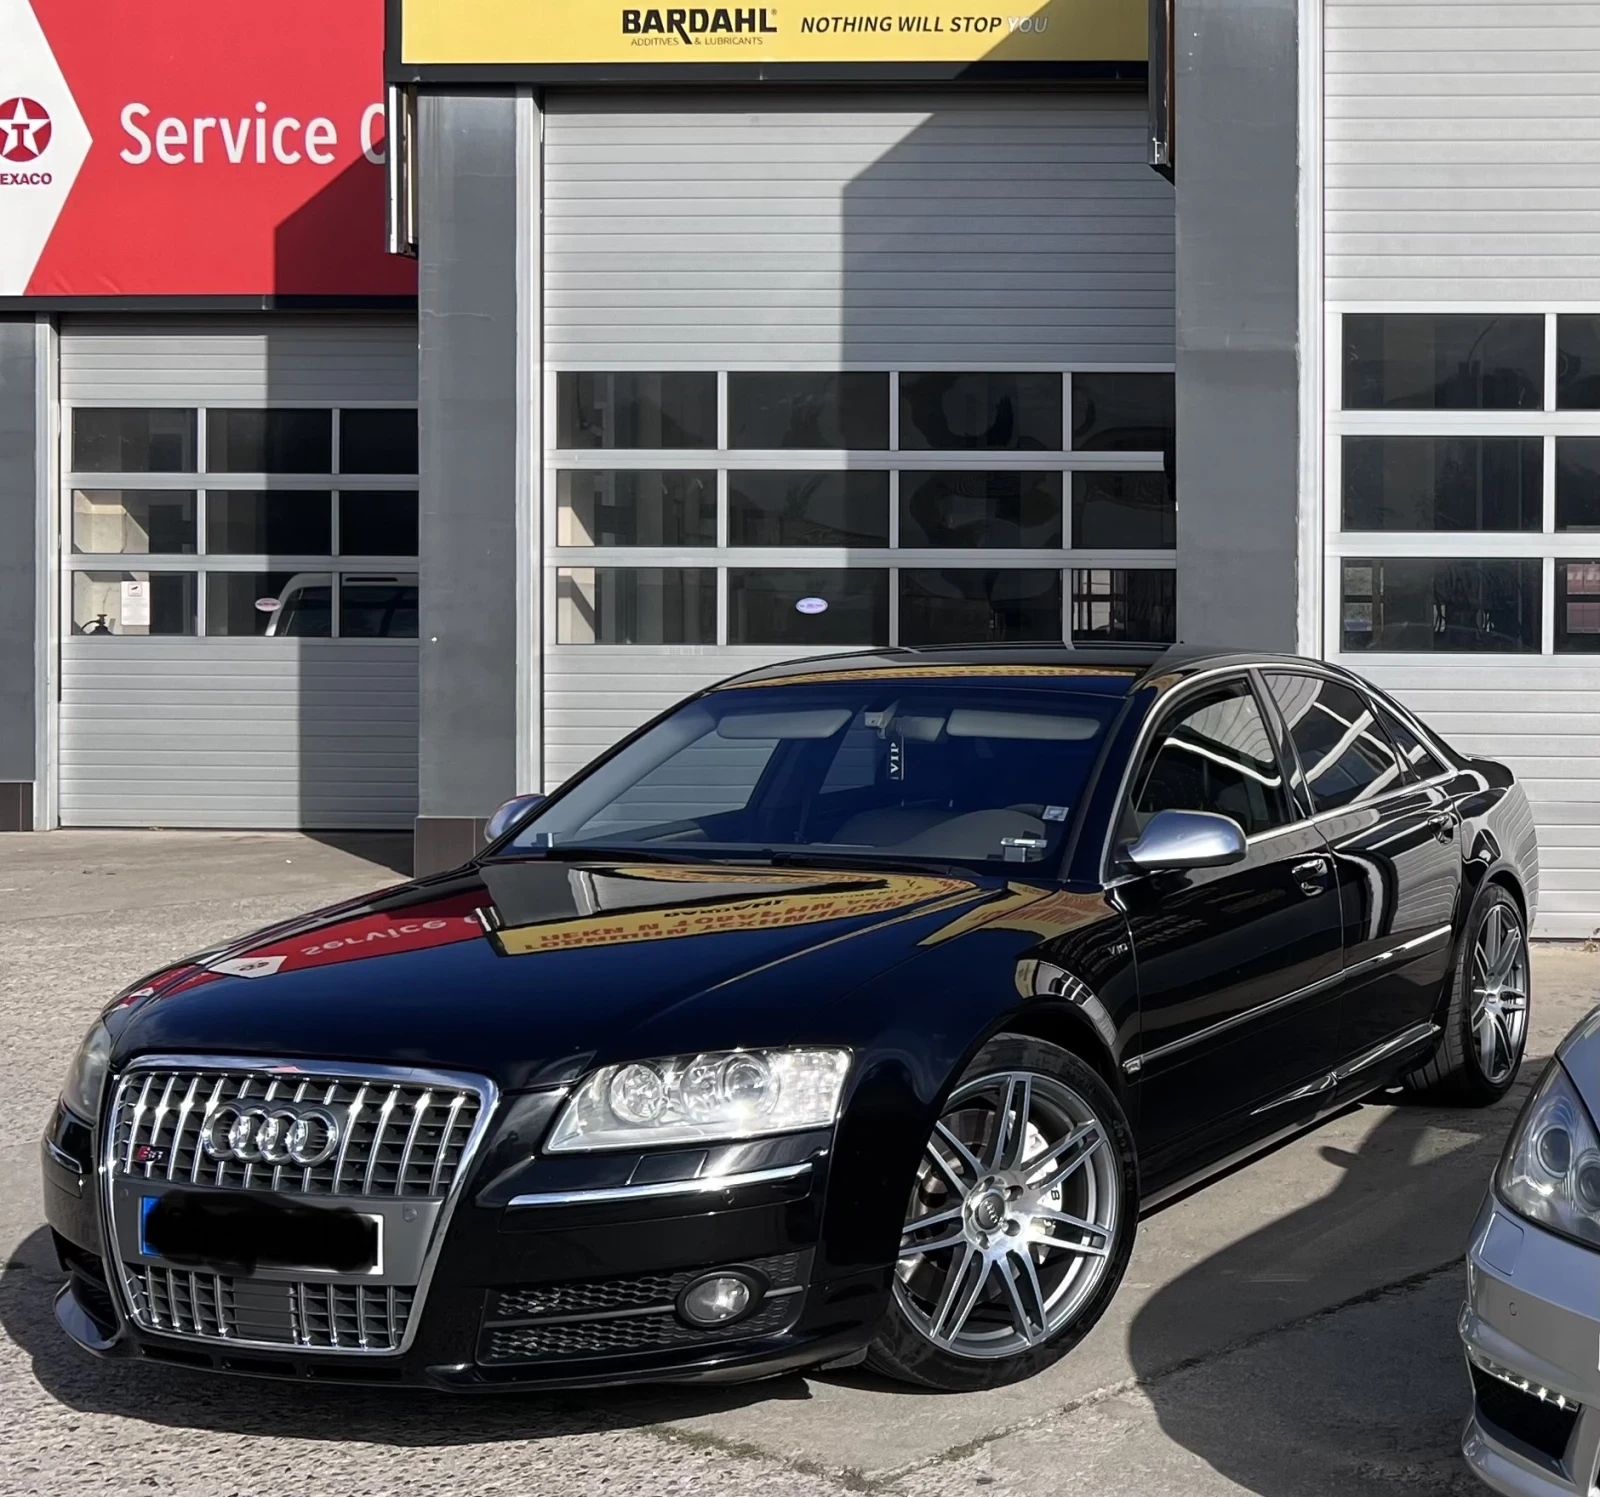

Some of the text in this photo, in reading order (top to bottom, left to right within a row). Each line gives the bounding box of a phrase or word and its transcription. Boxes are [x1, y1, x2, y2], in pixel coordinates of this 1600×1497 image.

[622, 8, 778, 45] BARDAHL
[800, 16, 1048, 33] NOTHING WILL STOP YOU
[630, 37, 763, 46] ADDITIVES & LUBRICANTS
[119, 101, 338, 165] Service
[0, 172, 53, 185] EXACO
[890, 742, 900, 774] VIP
